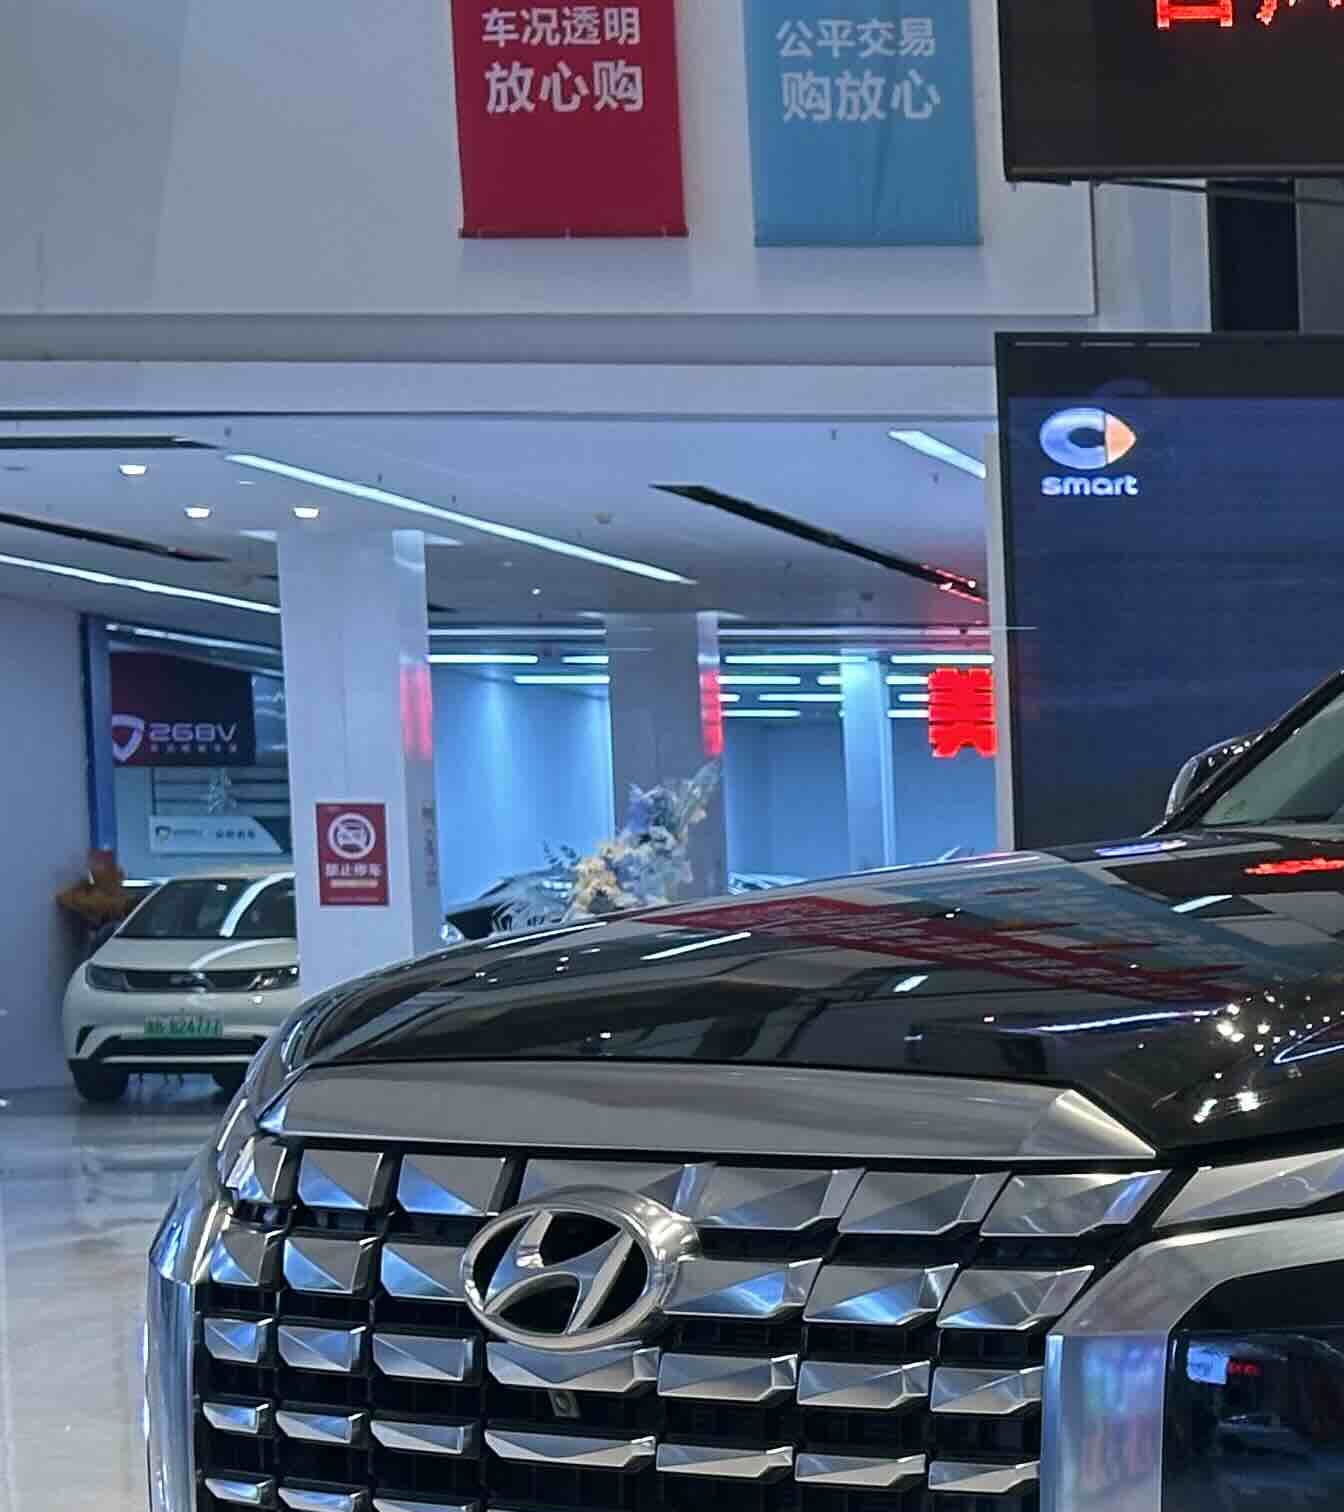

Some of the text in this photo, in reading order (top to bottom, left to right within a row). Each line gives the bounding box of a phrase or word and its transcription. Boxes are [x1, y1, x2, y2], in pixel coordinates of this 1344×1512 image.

[481, 6, 641, 48] 车况透明
[775, 16, 936, 58] 公平交易
[484, 59, 644, 114] 放心购
[781, 69, 941, 122] 购放心
[1041, 474, 1139, 496] smart
